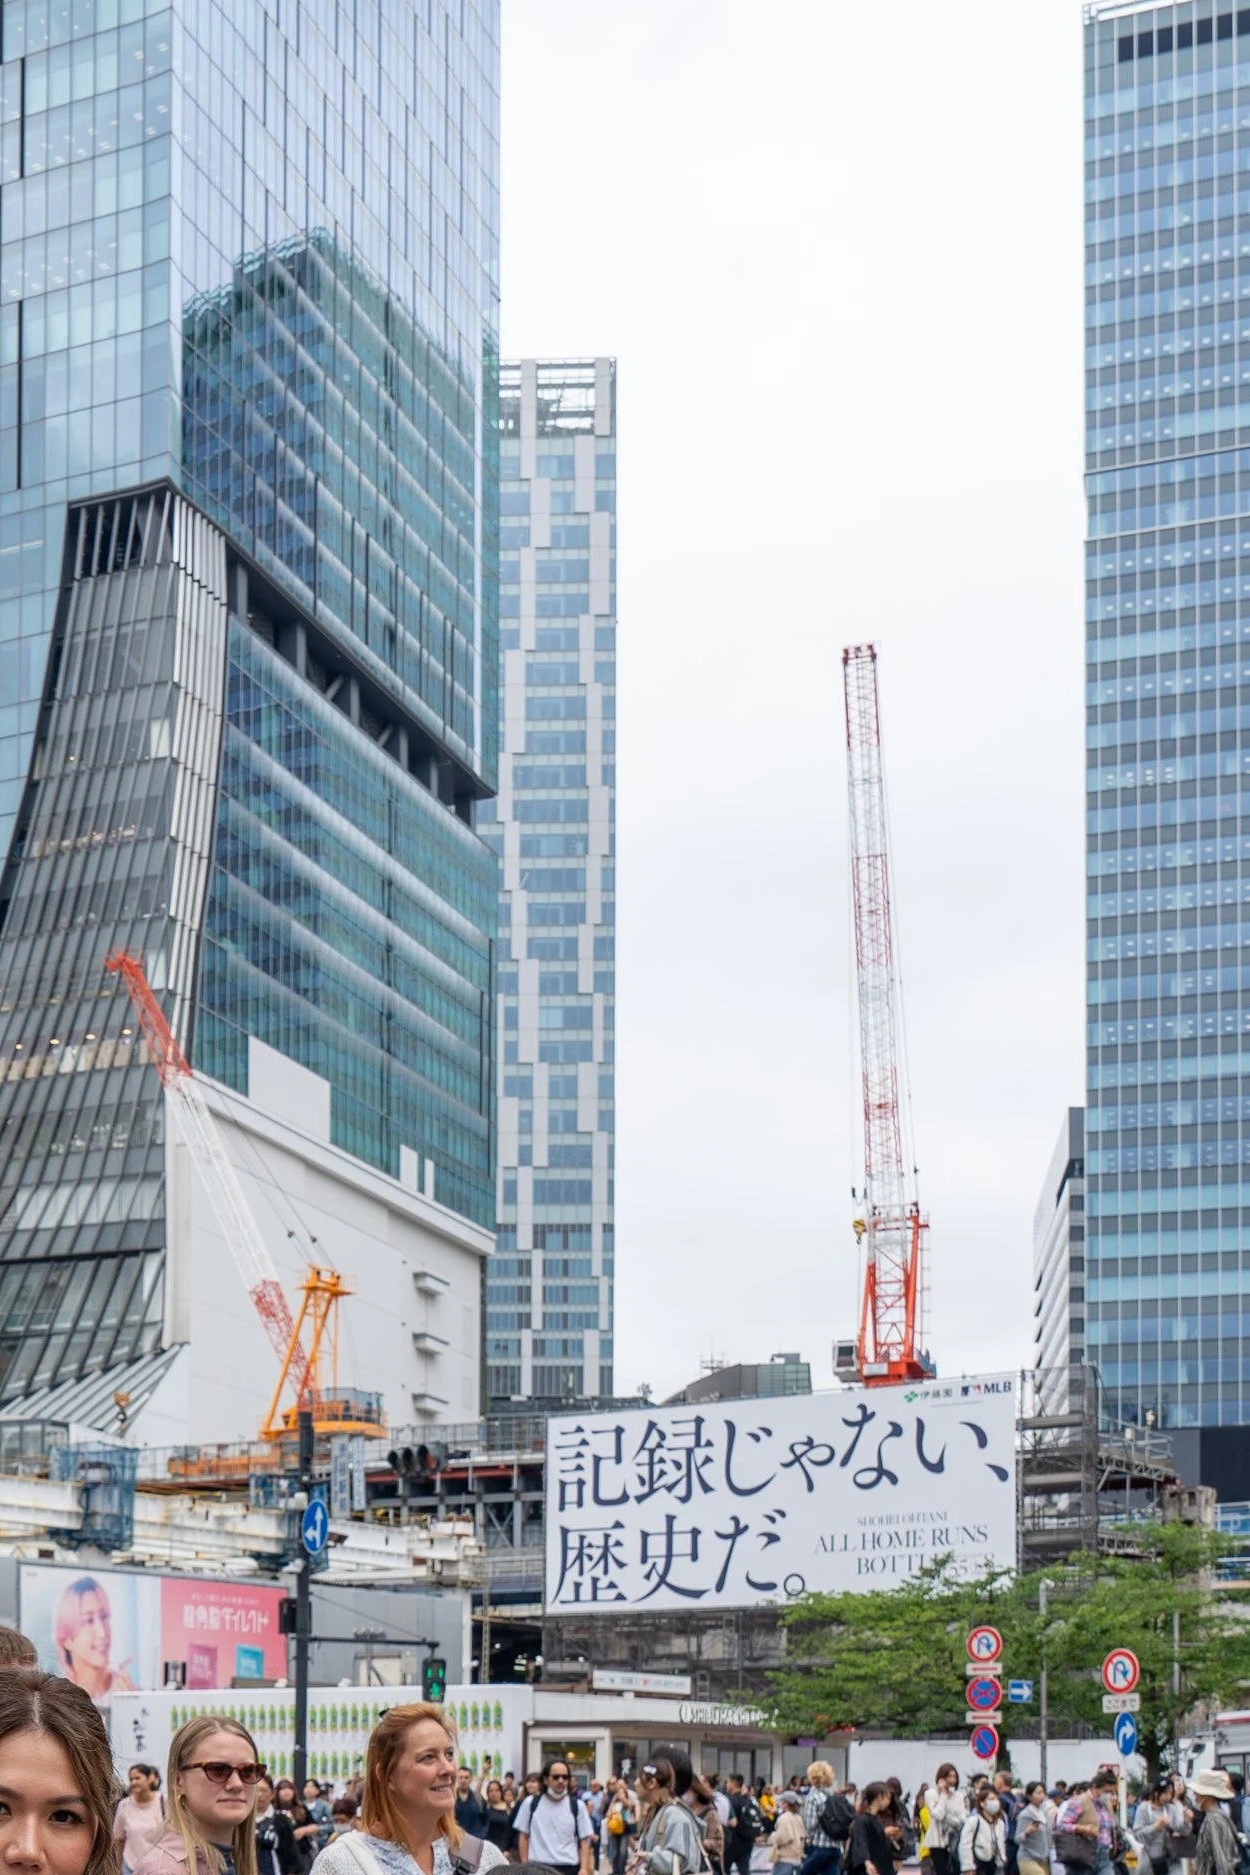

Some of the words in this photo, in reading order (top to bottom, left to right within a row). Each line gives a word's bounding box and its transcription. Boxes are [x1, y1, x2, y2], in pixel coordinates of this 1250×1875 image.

[984, 1381, 1012, 1395] MLB
[554, 1402, 1010, 1512] 記録じゃない、
[857, 1515, 900, 1527] SHOHEI
[902, 1511, 948, 1524] OHTANI
[814, 1533, 856, 1553] ALL
[862, 1528, 926, 1551] HOME
[932, 1524, 989, 1546] RUNS
[552, 1508, 806, 1605] 歴史だ。
